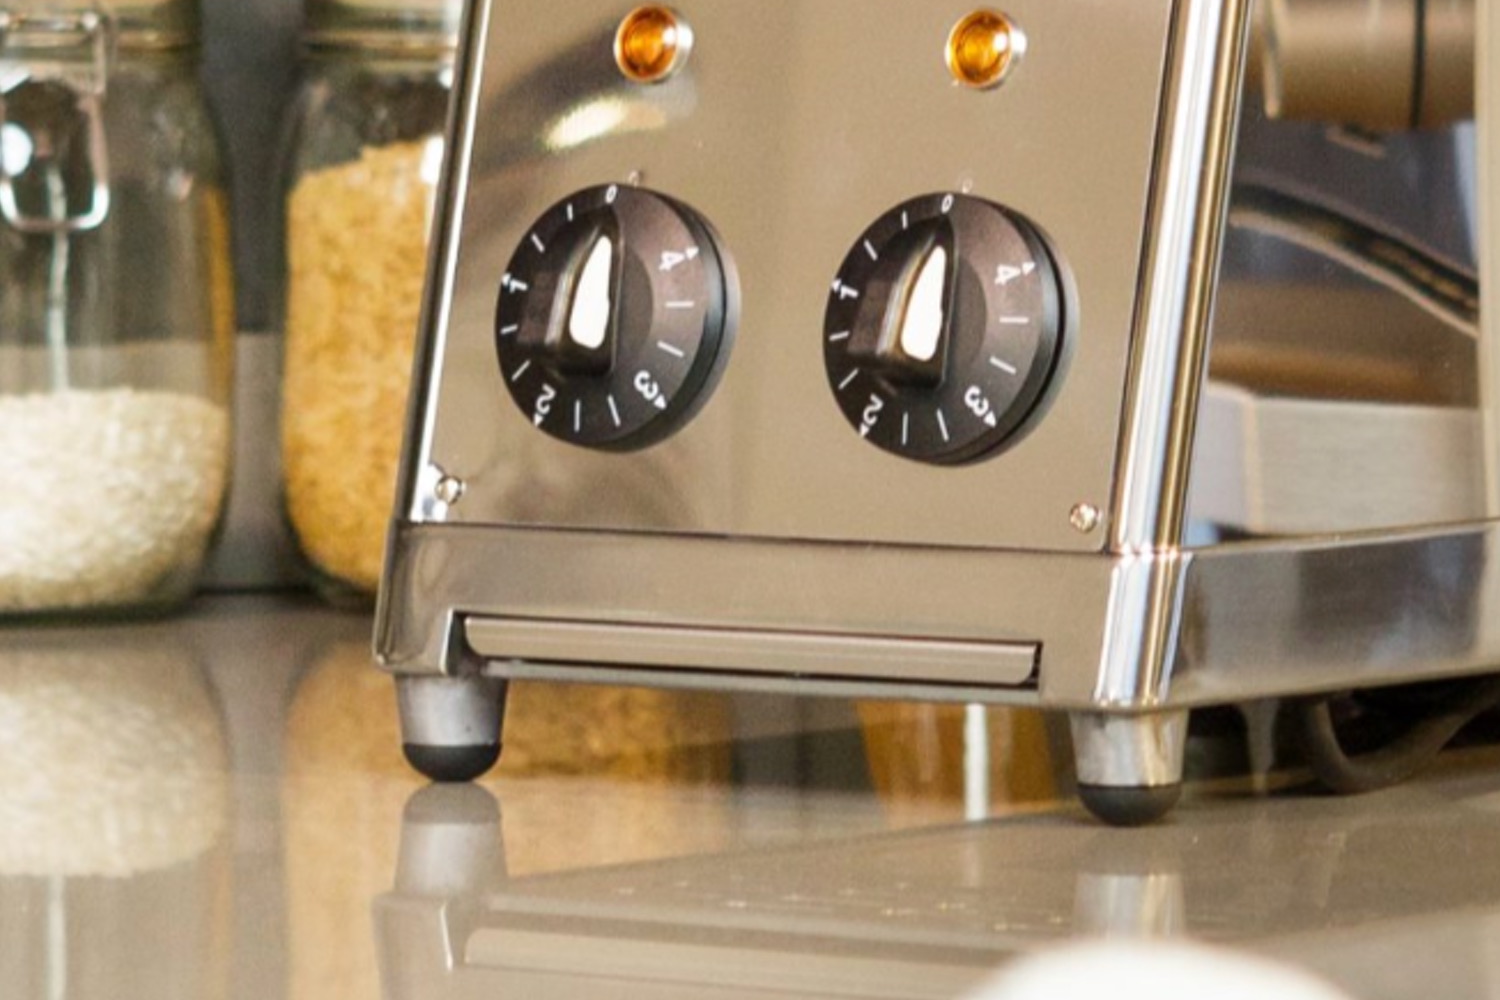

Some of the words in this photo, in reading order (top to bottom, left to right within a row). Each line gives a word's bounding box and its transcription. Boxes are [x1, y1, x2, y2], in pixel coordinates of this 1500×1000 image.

[605, 184, 618, 204] 0
[941, 193, 954, 213] 0
[659, 250, 686, 270] 4
[994, 263, 1022, 285] 4
[509, 279, 528, 294] 1
[839, 285, 858, 300] 1
[633, 370, 659, 400] 3
[536, 384, 556, 414] 2
[964, 385, 989, 417] 3
[862, 394, 884, 426] 2
